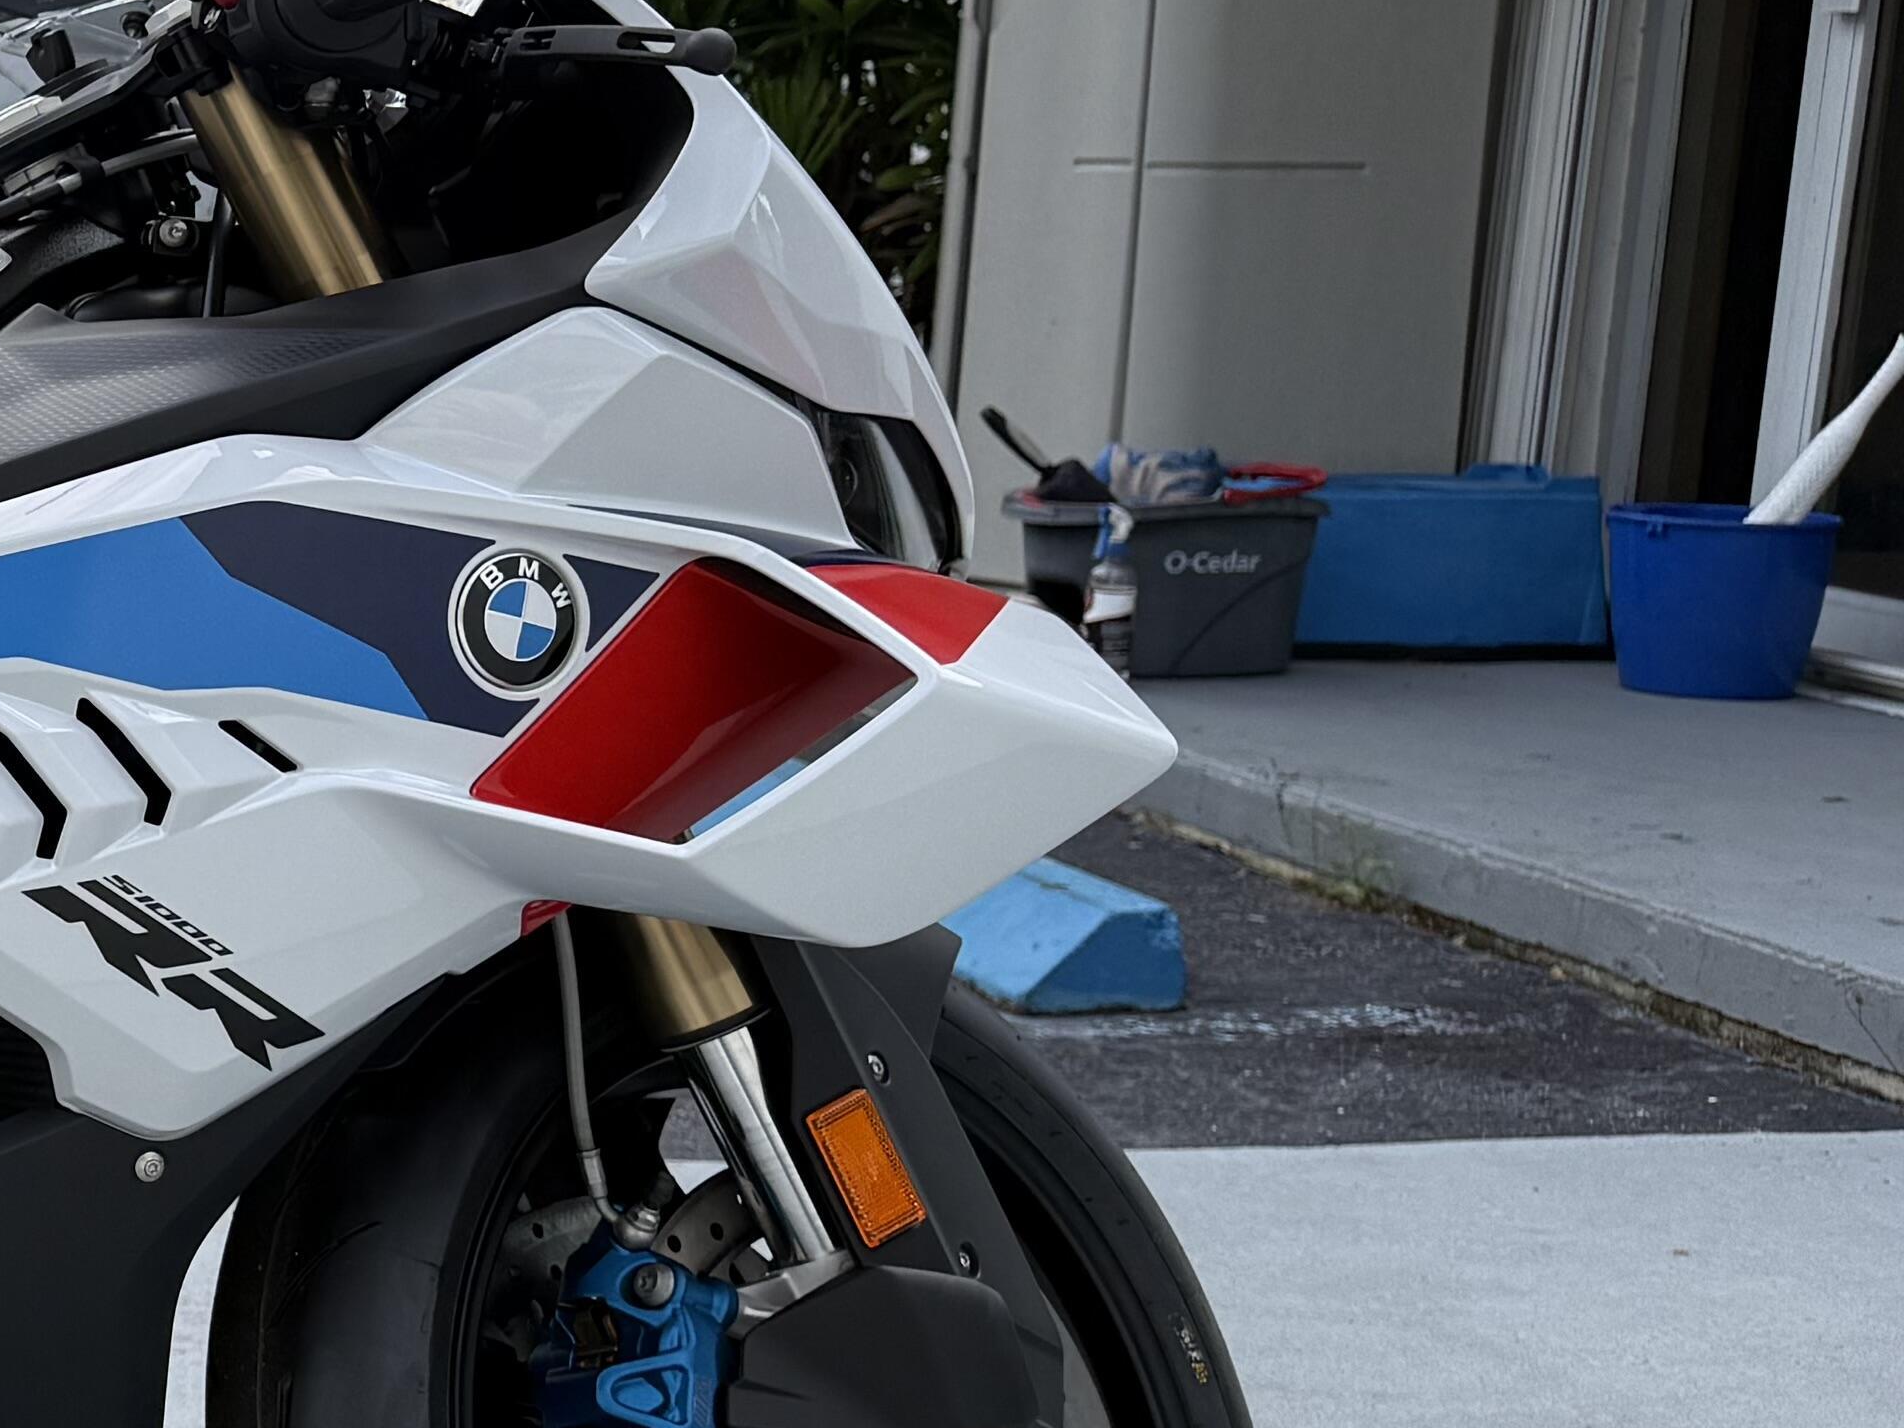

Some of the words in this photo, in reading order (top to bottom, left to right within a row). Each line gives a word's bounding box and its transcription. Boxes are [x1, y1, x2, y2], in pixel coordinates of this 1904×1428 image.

[480, 557, 571, 609] BMW
[103, 874, 234, 956] S1000
[21, 879, 326, 1072] RR
